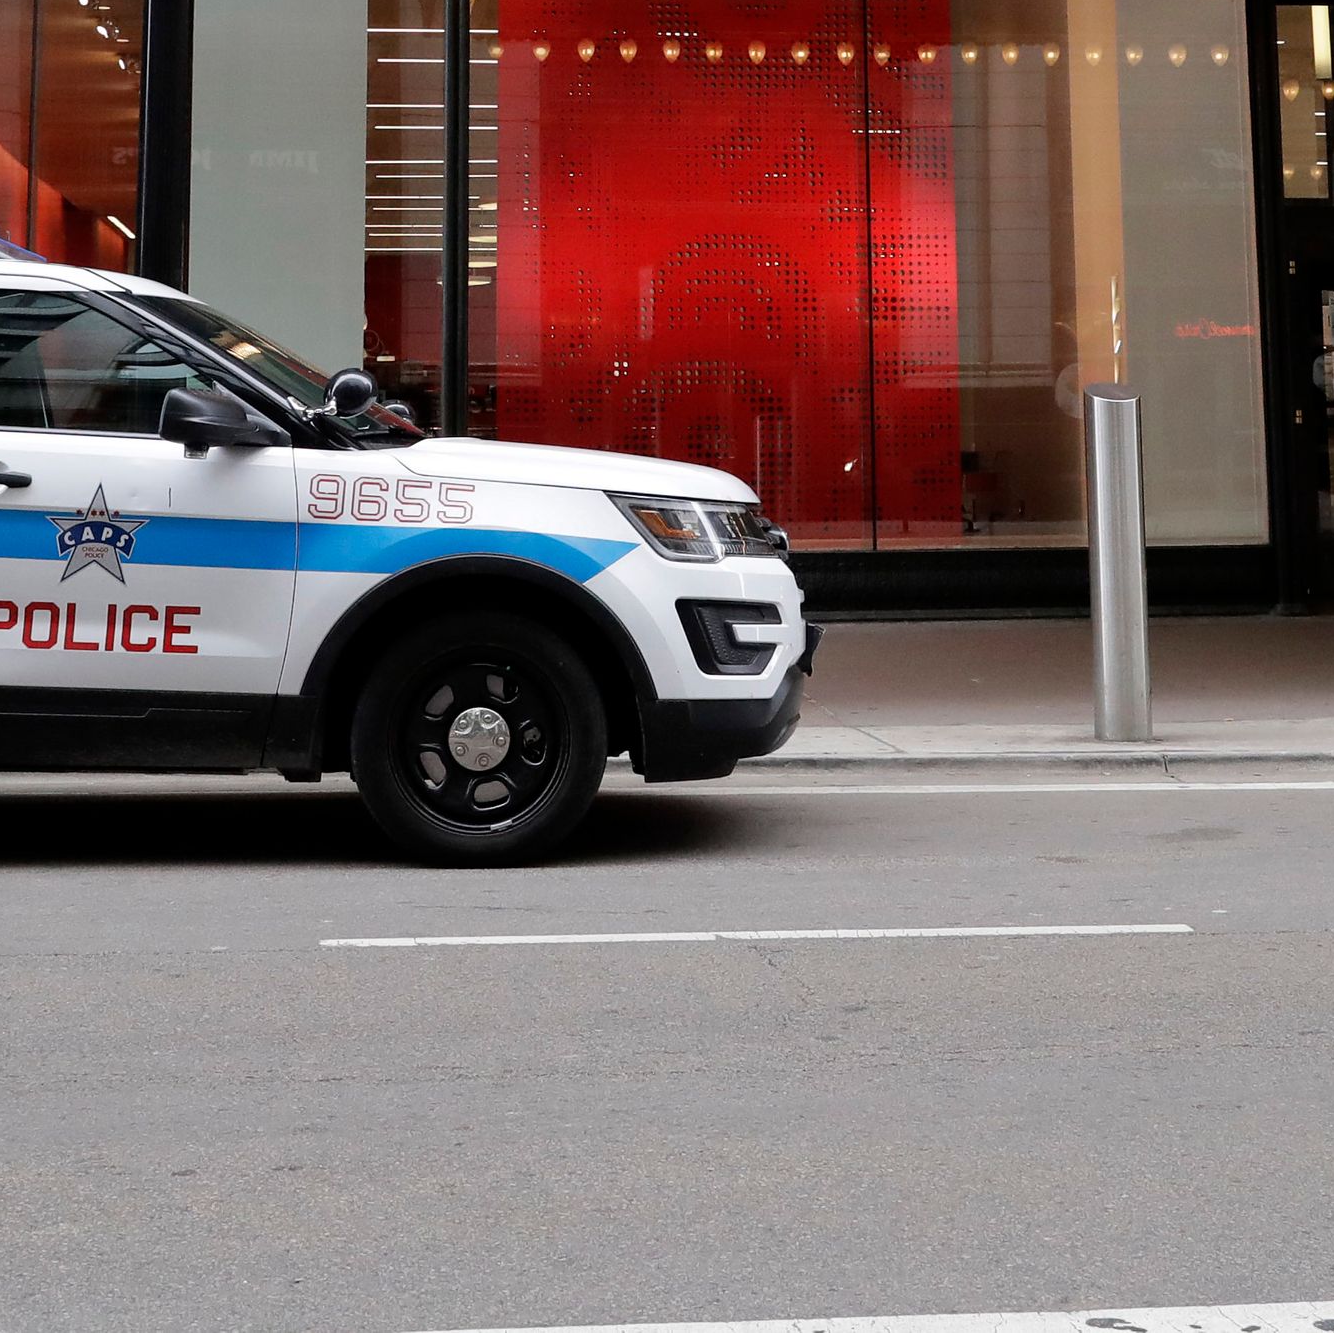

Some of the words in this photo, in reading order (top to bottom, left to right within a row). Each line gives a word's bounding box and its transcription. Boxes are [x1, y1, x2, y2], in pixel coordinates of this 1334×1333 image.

[308, 473, 477, 525] 9655
[63, 526, 129, 547] CAPS
[81, 546, 109, 554] CHICAGO
